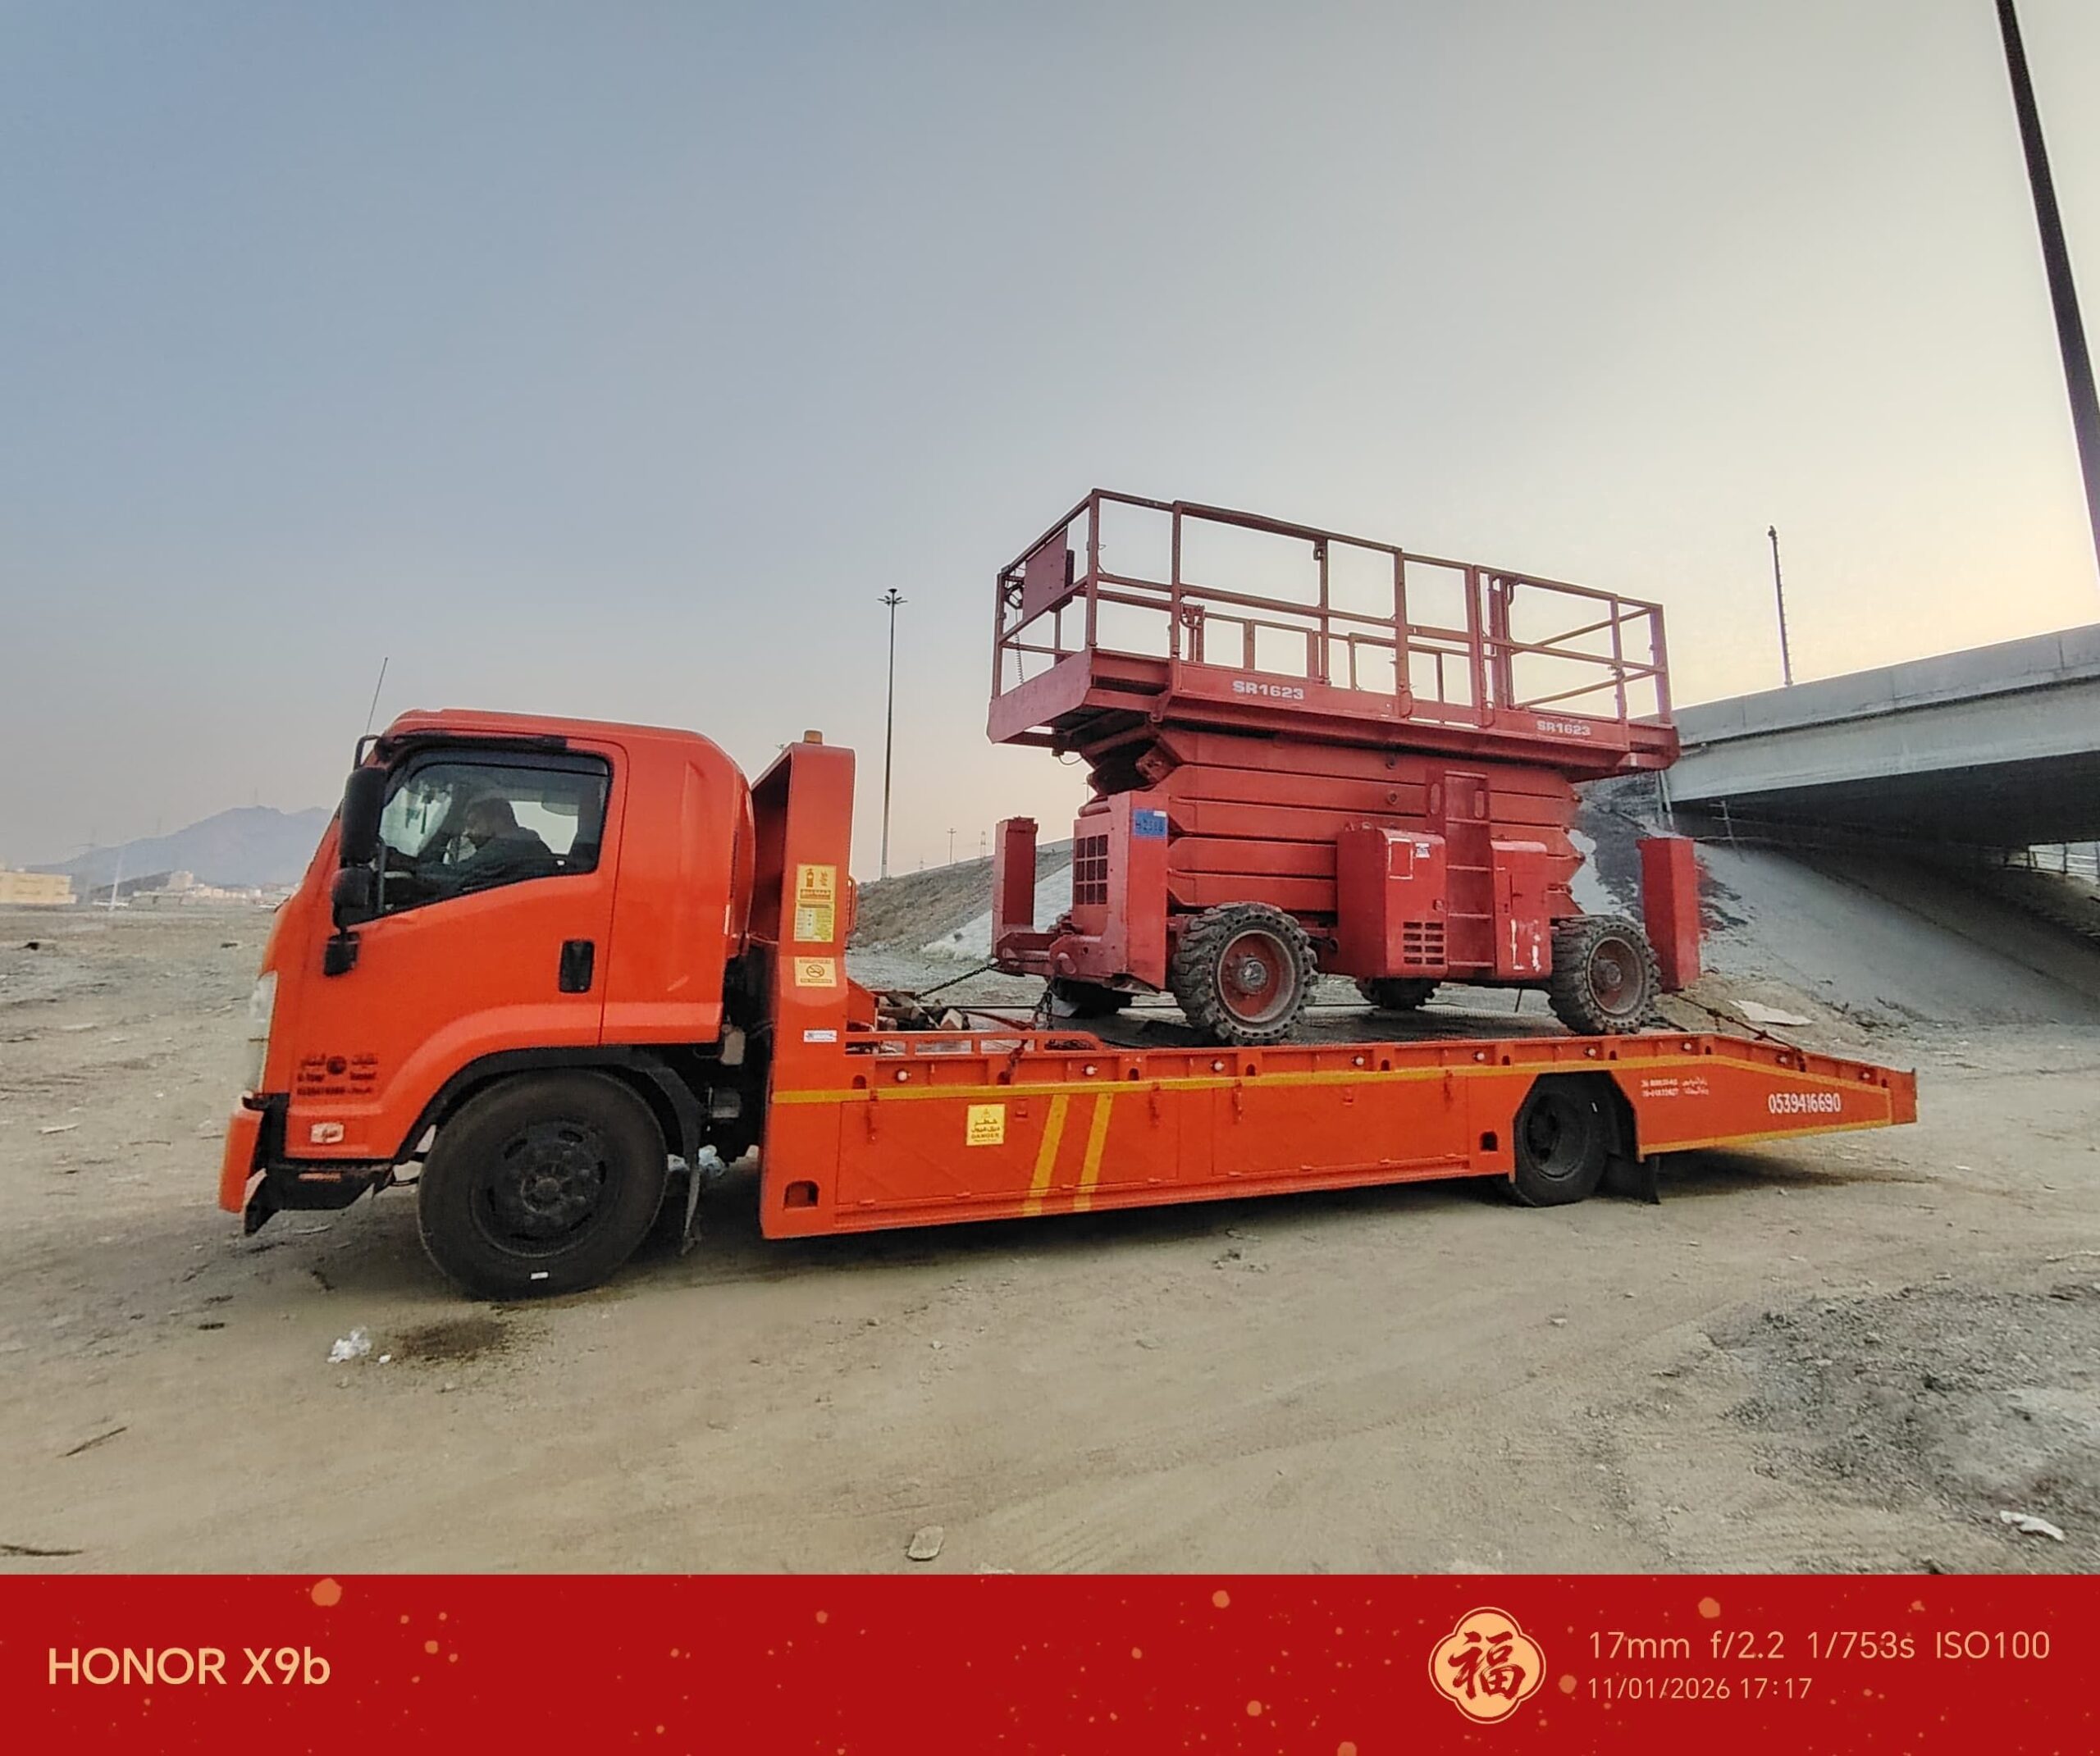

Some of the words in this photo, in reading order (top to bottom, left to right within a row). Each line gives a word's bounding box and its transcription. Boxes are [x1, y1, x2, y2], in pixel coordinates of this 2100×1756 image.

[1232, 680, 1303, 700] SR1623
[1536, 720, 1591, 736] SR1623
[1768, 1092, 1841, 1114] 0539416690
